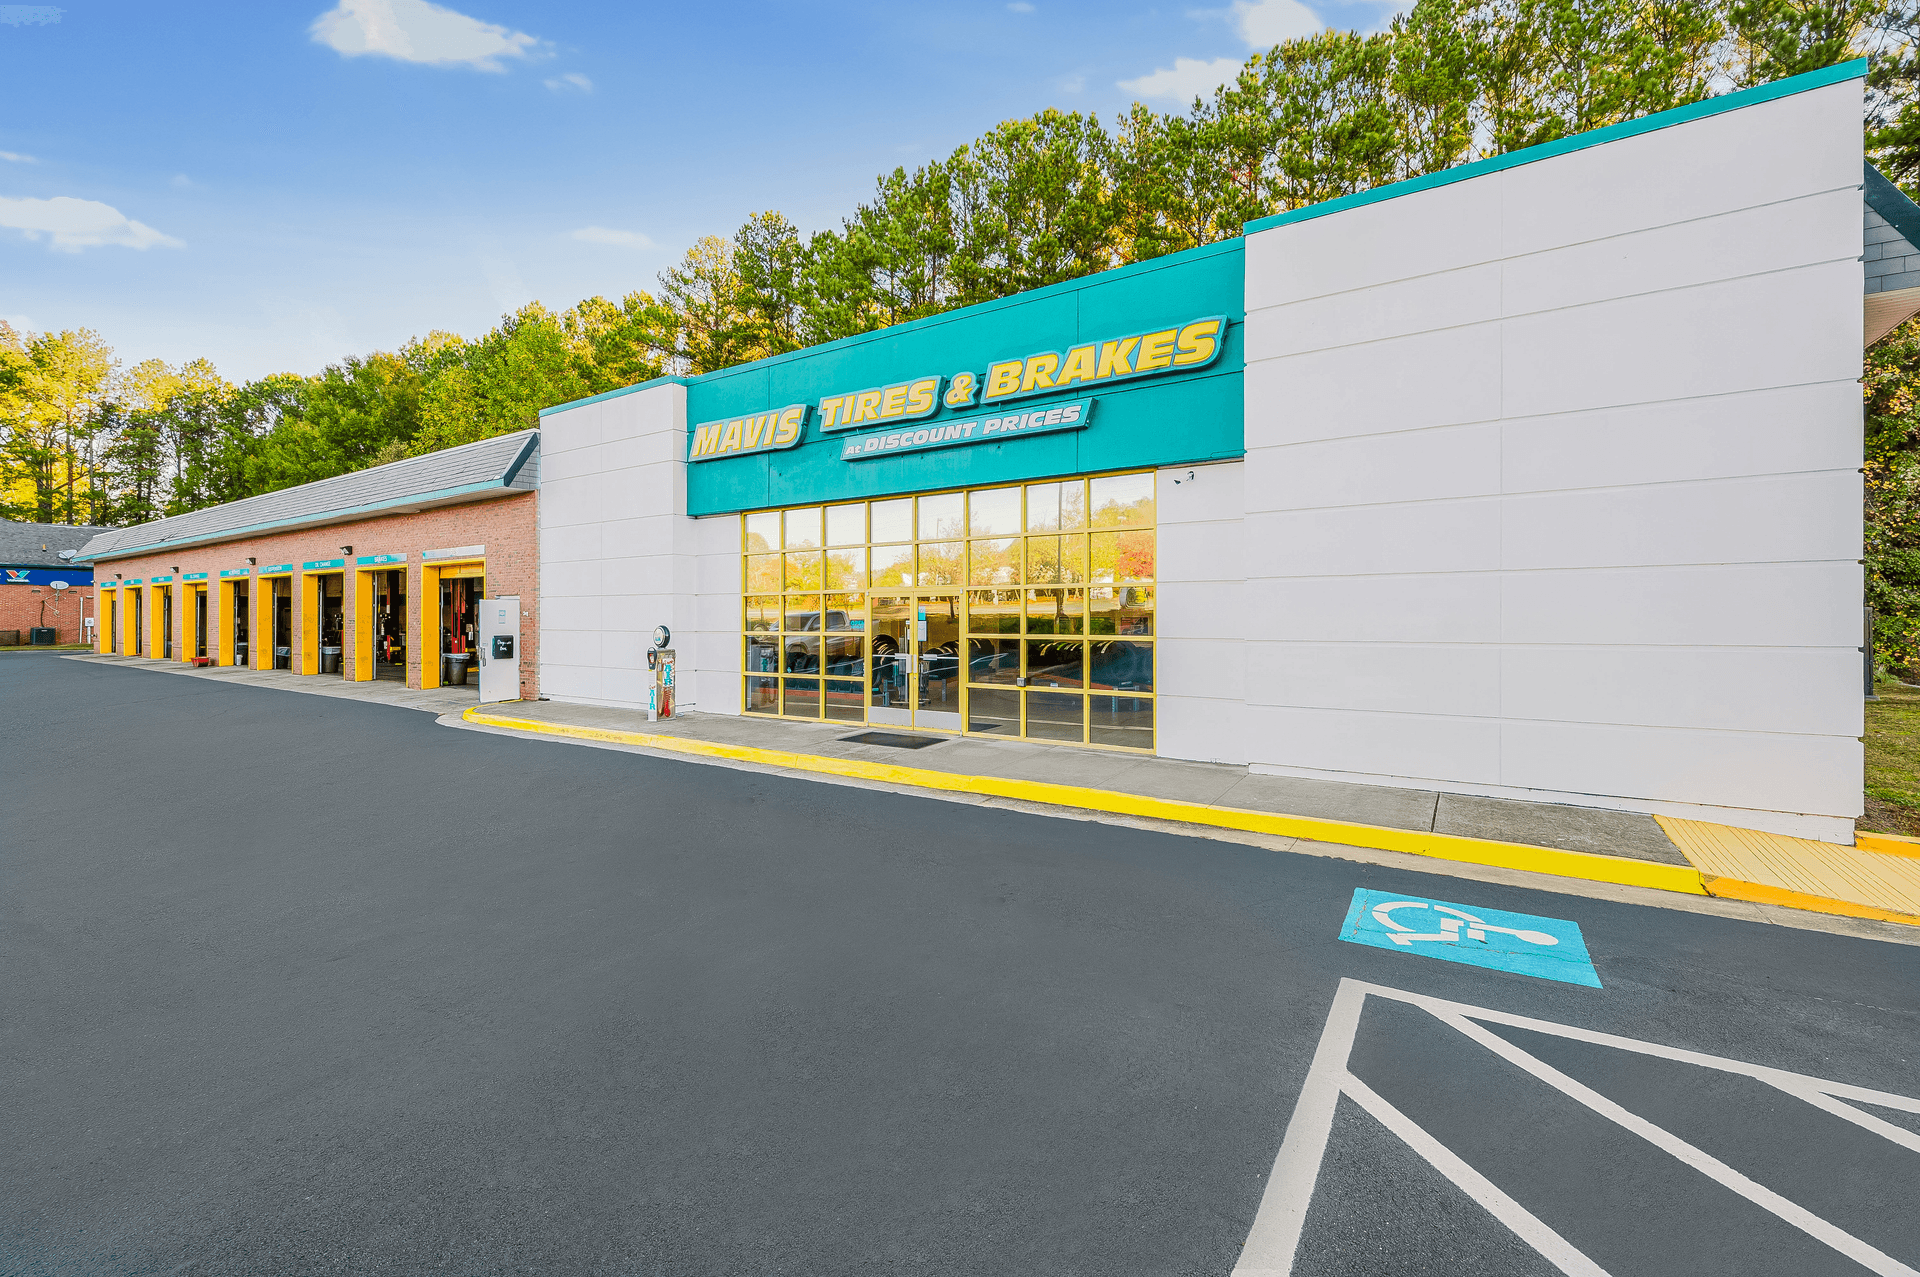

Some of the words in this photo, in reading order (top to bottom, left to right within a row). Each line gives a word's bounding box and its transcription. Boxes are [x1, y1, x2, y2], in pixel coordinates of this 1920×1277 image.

[691, 408, 802, 457] MAVIS
[822, 380, 936, 427] TIRES
[945, 374, 974, 405] &
[986, 320, 1222, 399] BRAKES
[845, 444, 862, 455] At
[863, 421, 978, 453] DISCOUNT
[982, 405, 1082, 435] PRICES
[648, 689, 656, 710] AIR
